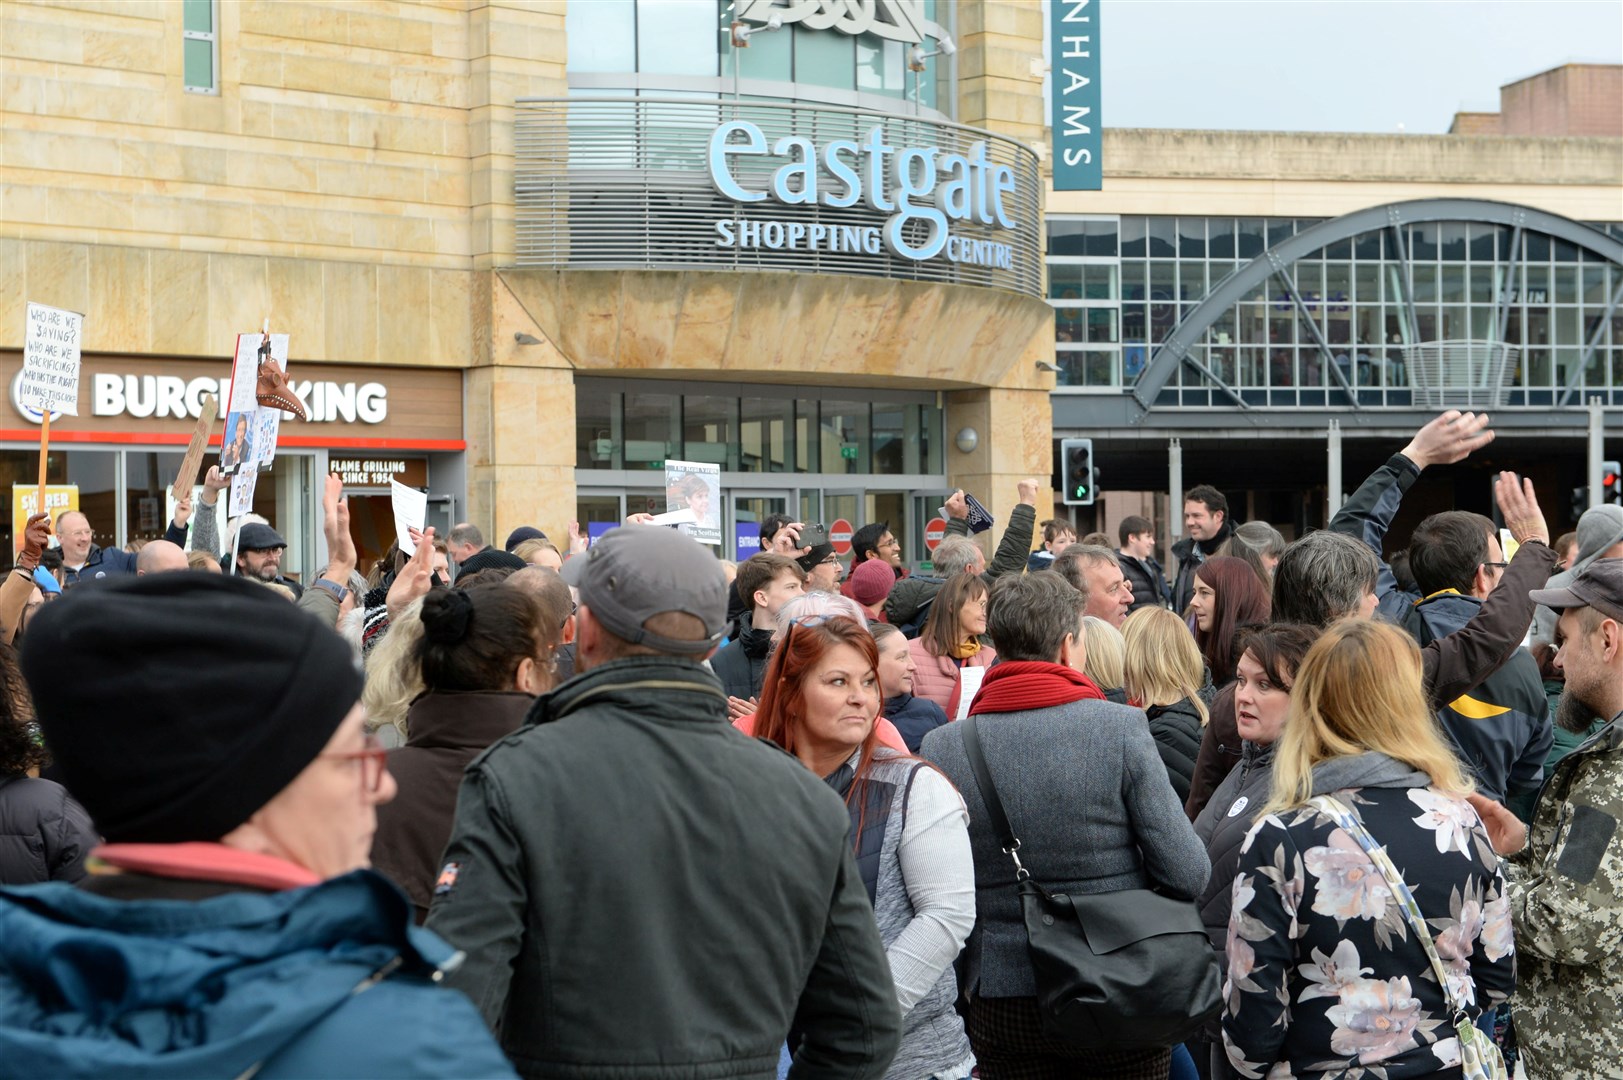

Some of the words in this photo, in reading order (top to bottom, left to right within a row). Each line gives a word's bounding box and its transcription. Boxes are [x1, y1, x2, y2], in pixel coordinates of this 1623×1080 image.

[706, 120, 1017, 261] eastgate
[715, 218, 881, 255] SHOPPING
[946, 235, 1013, 271] CENTRE
[31, 308, 47, 323] WHO
[48, 312, 61, 326] ARE
[65, 316, 76, 329] WE
[36, 325, 77, 344] SAYING?
[28, 340, 43, 354] WHO
[45, 344, 58, 357] ARE
[61, 347, 72, 360] WE
[92, 373, 232, 419] BURG
[330, 460, 360, 472] FLAME
[362, 461, 406, 473] GRILLING
[342, 472, 369, 484] SINCE
[21, 492, 69, 510] SHRER
